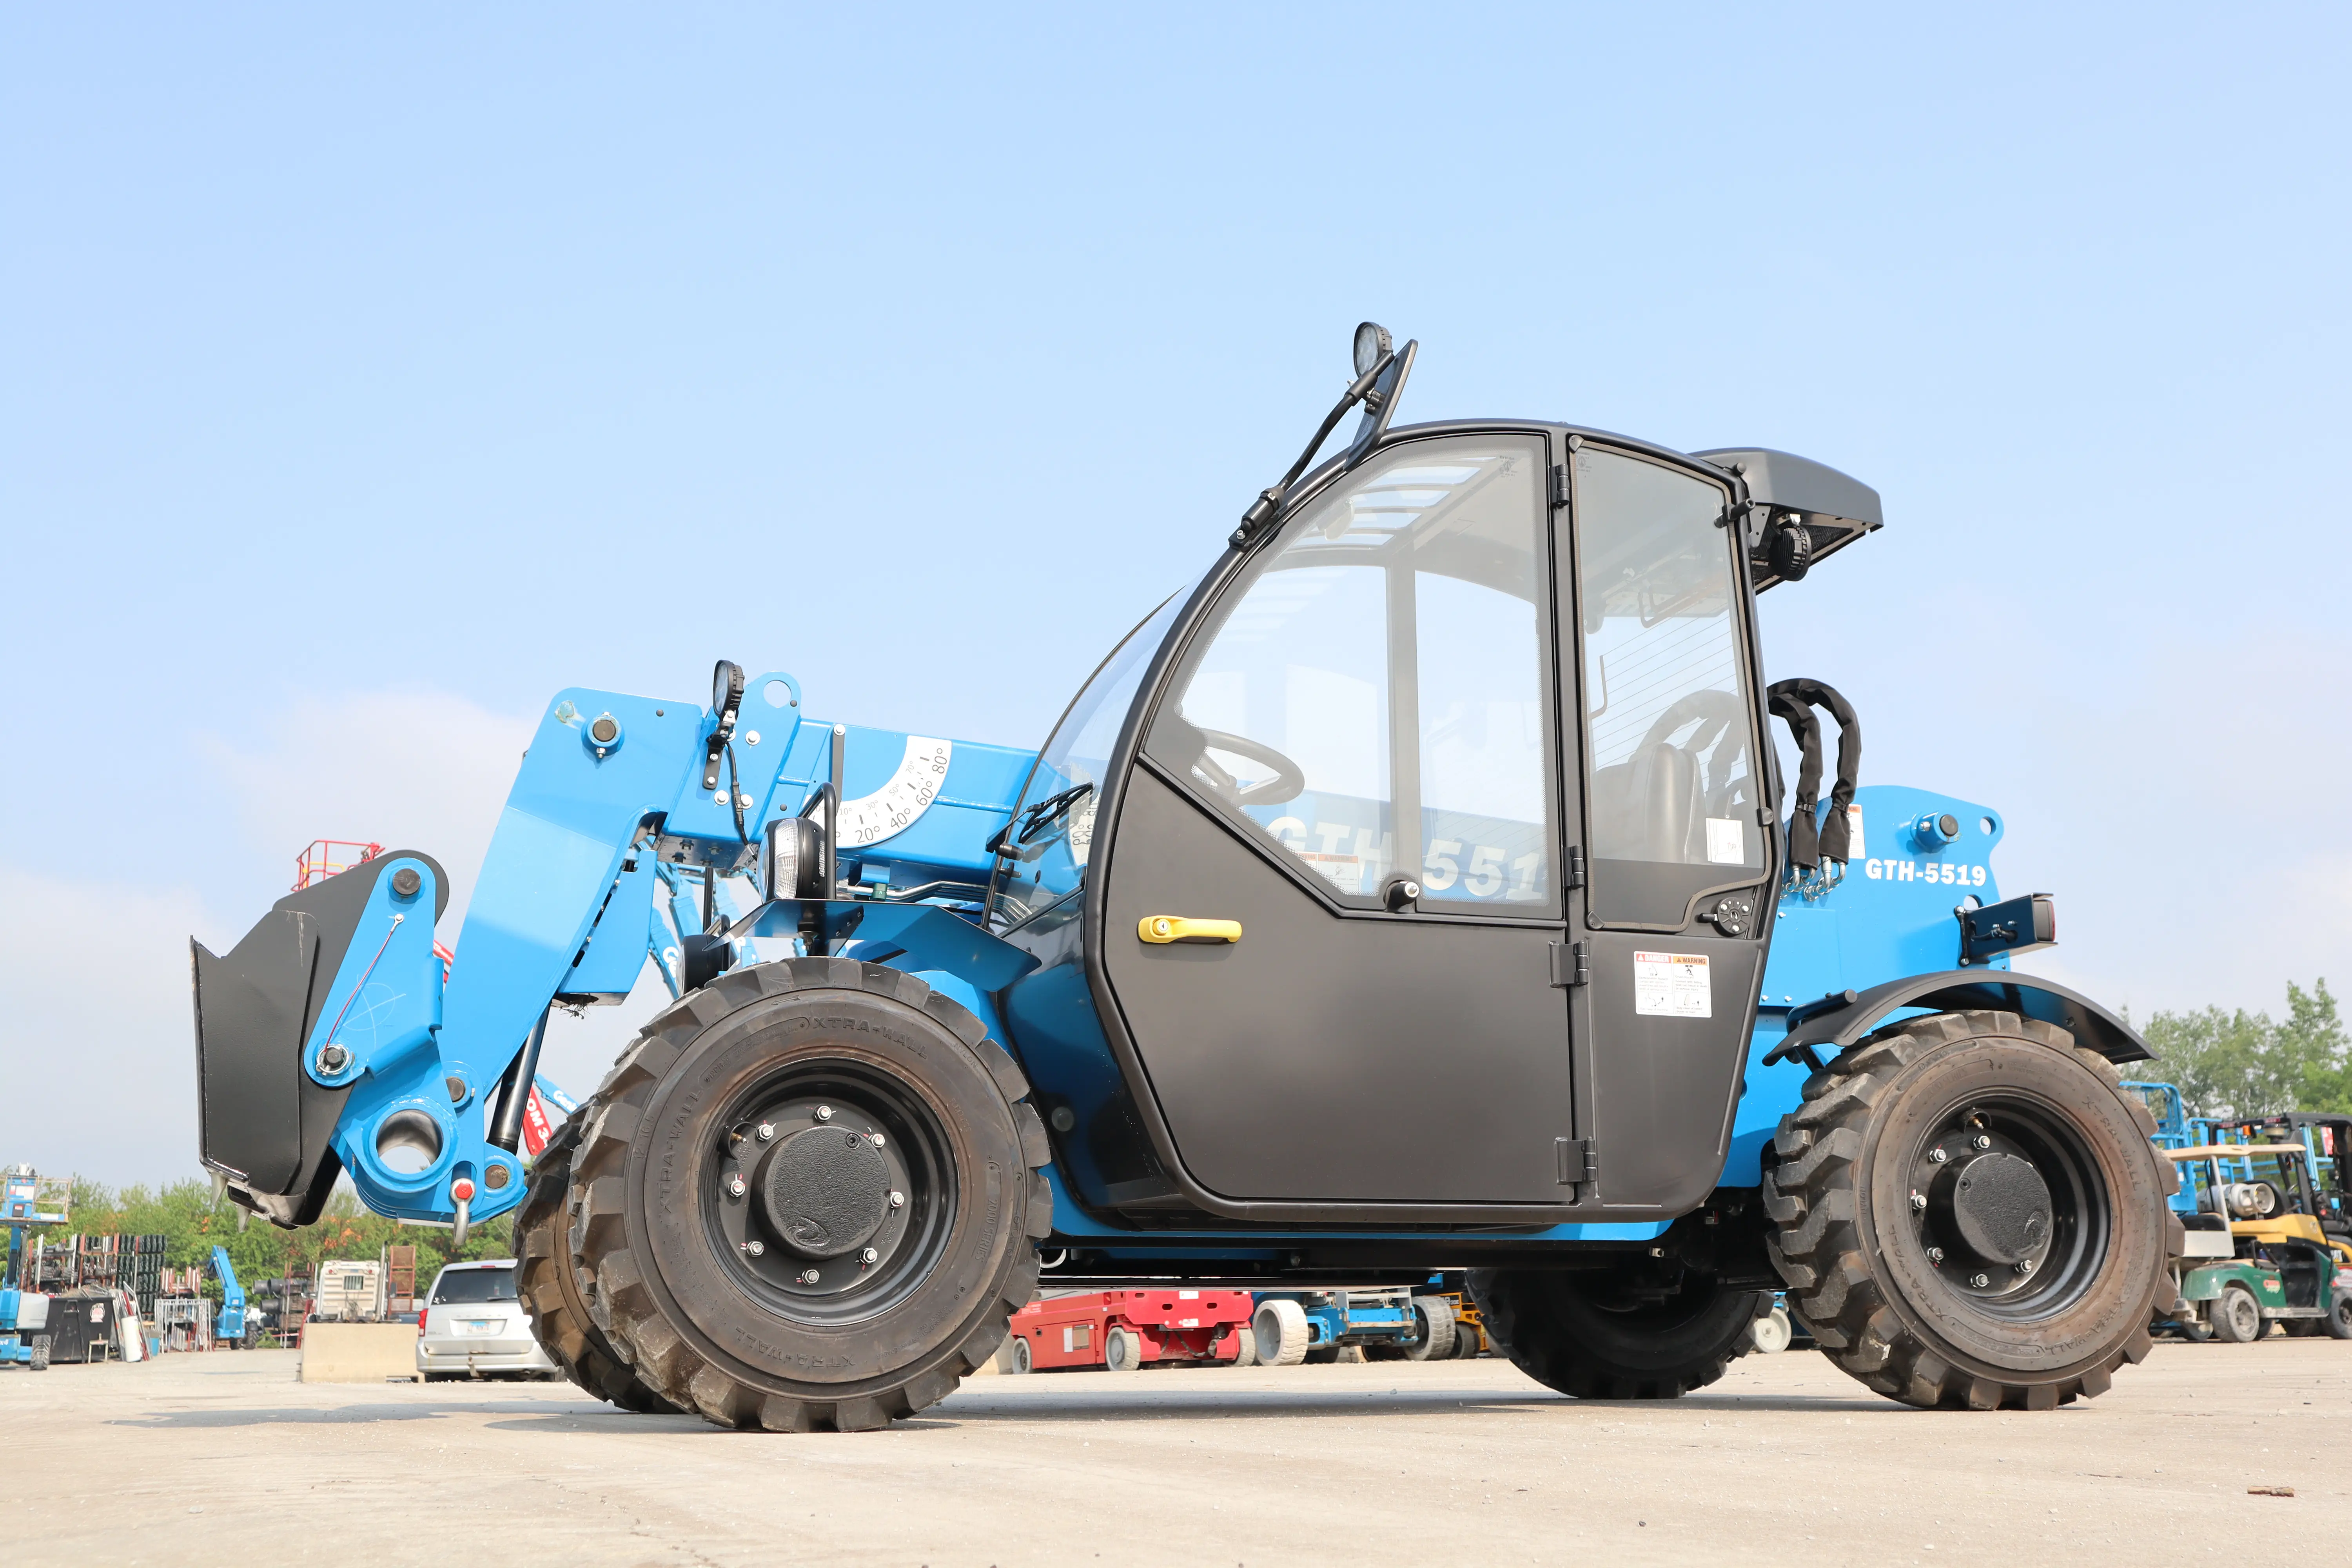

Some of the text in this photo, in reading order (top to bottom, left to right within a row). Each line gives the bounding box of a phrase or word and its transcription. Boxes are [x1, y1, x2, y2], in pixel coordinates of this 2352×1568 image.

[1866, 858, 1986, 886] GTH-5519
[953, 1042, 978, 1068] NYLON
[975, 1198, 998, 1262] 2000 SERIES
